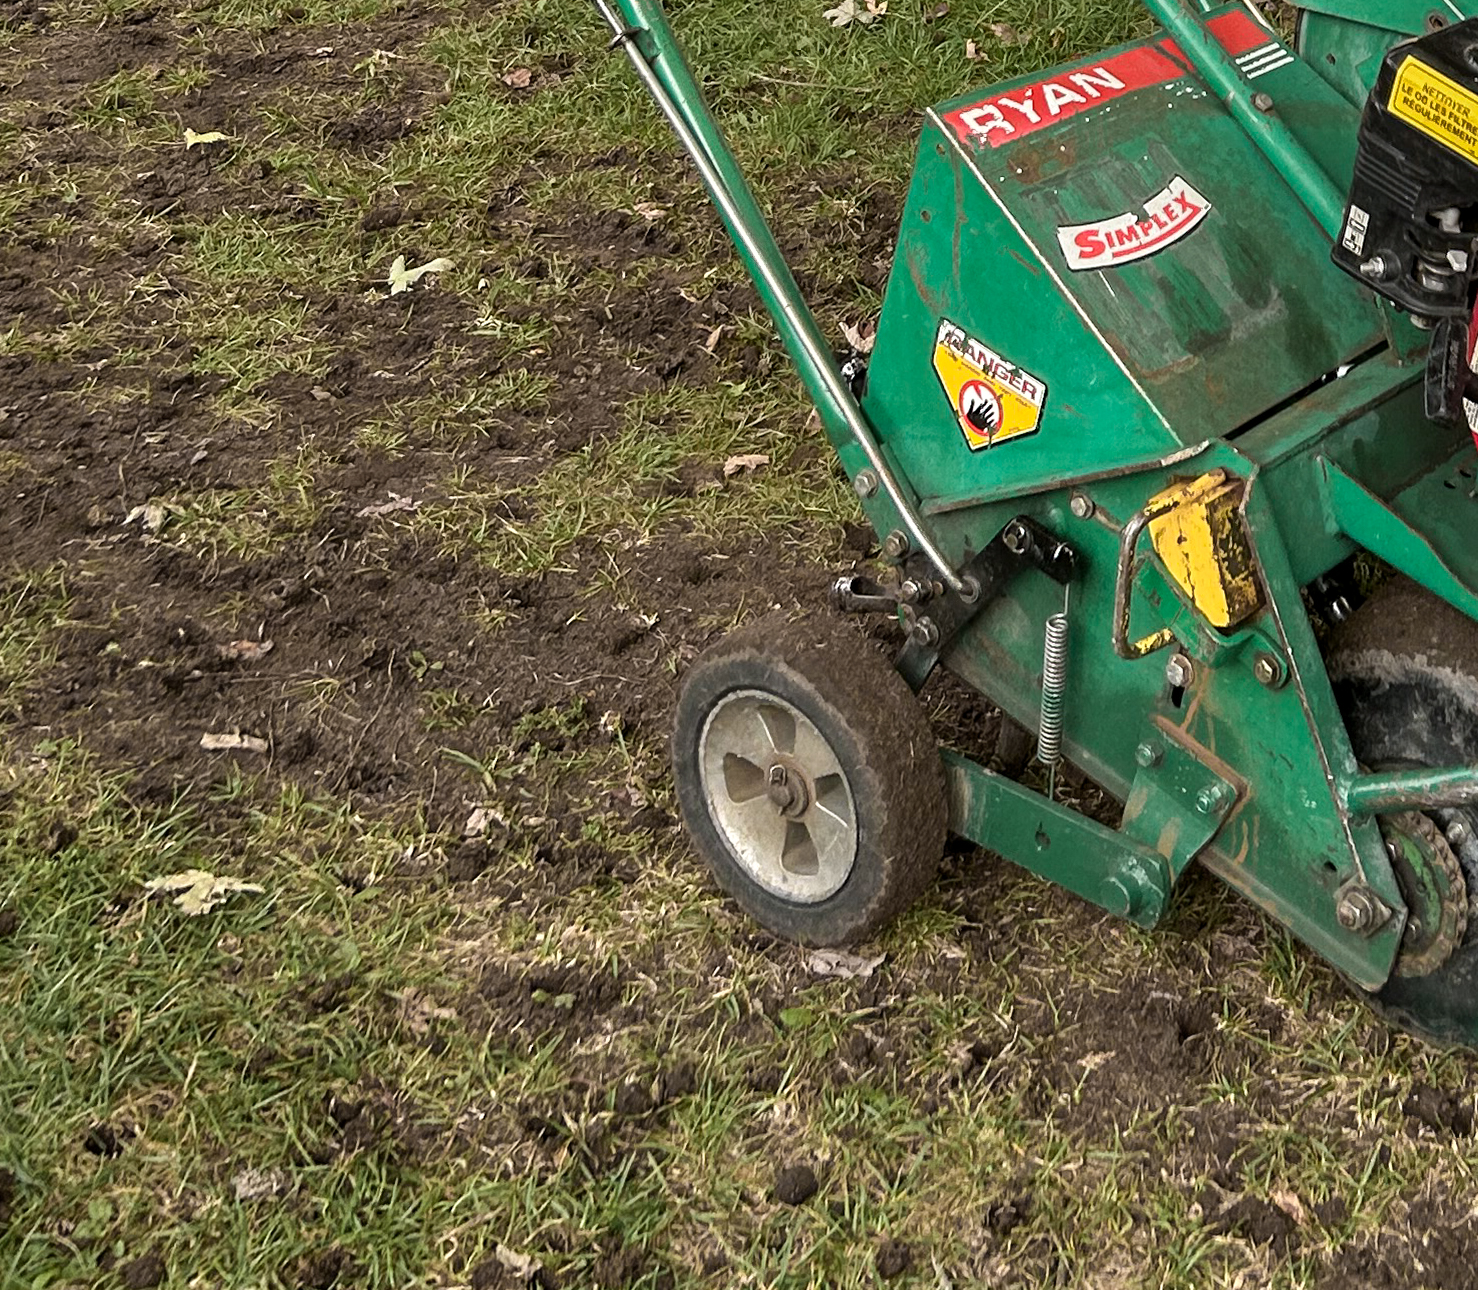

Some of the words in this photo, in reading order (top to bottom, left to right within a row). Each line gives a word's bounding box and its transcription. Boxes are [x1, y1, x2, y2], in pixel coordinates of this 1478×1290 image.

[959, 67, 1126, 142] RYAN
[1401, 82, 1414, 97] LE
[1430, 100, 1447, 117] LES
[1074, 190, 1197, 259] SIMPLEX
[943, 328, 1038, 401] DANGER
